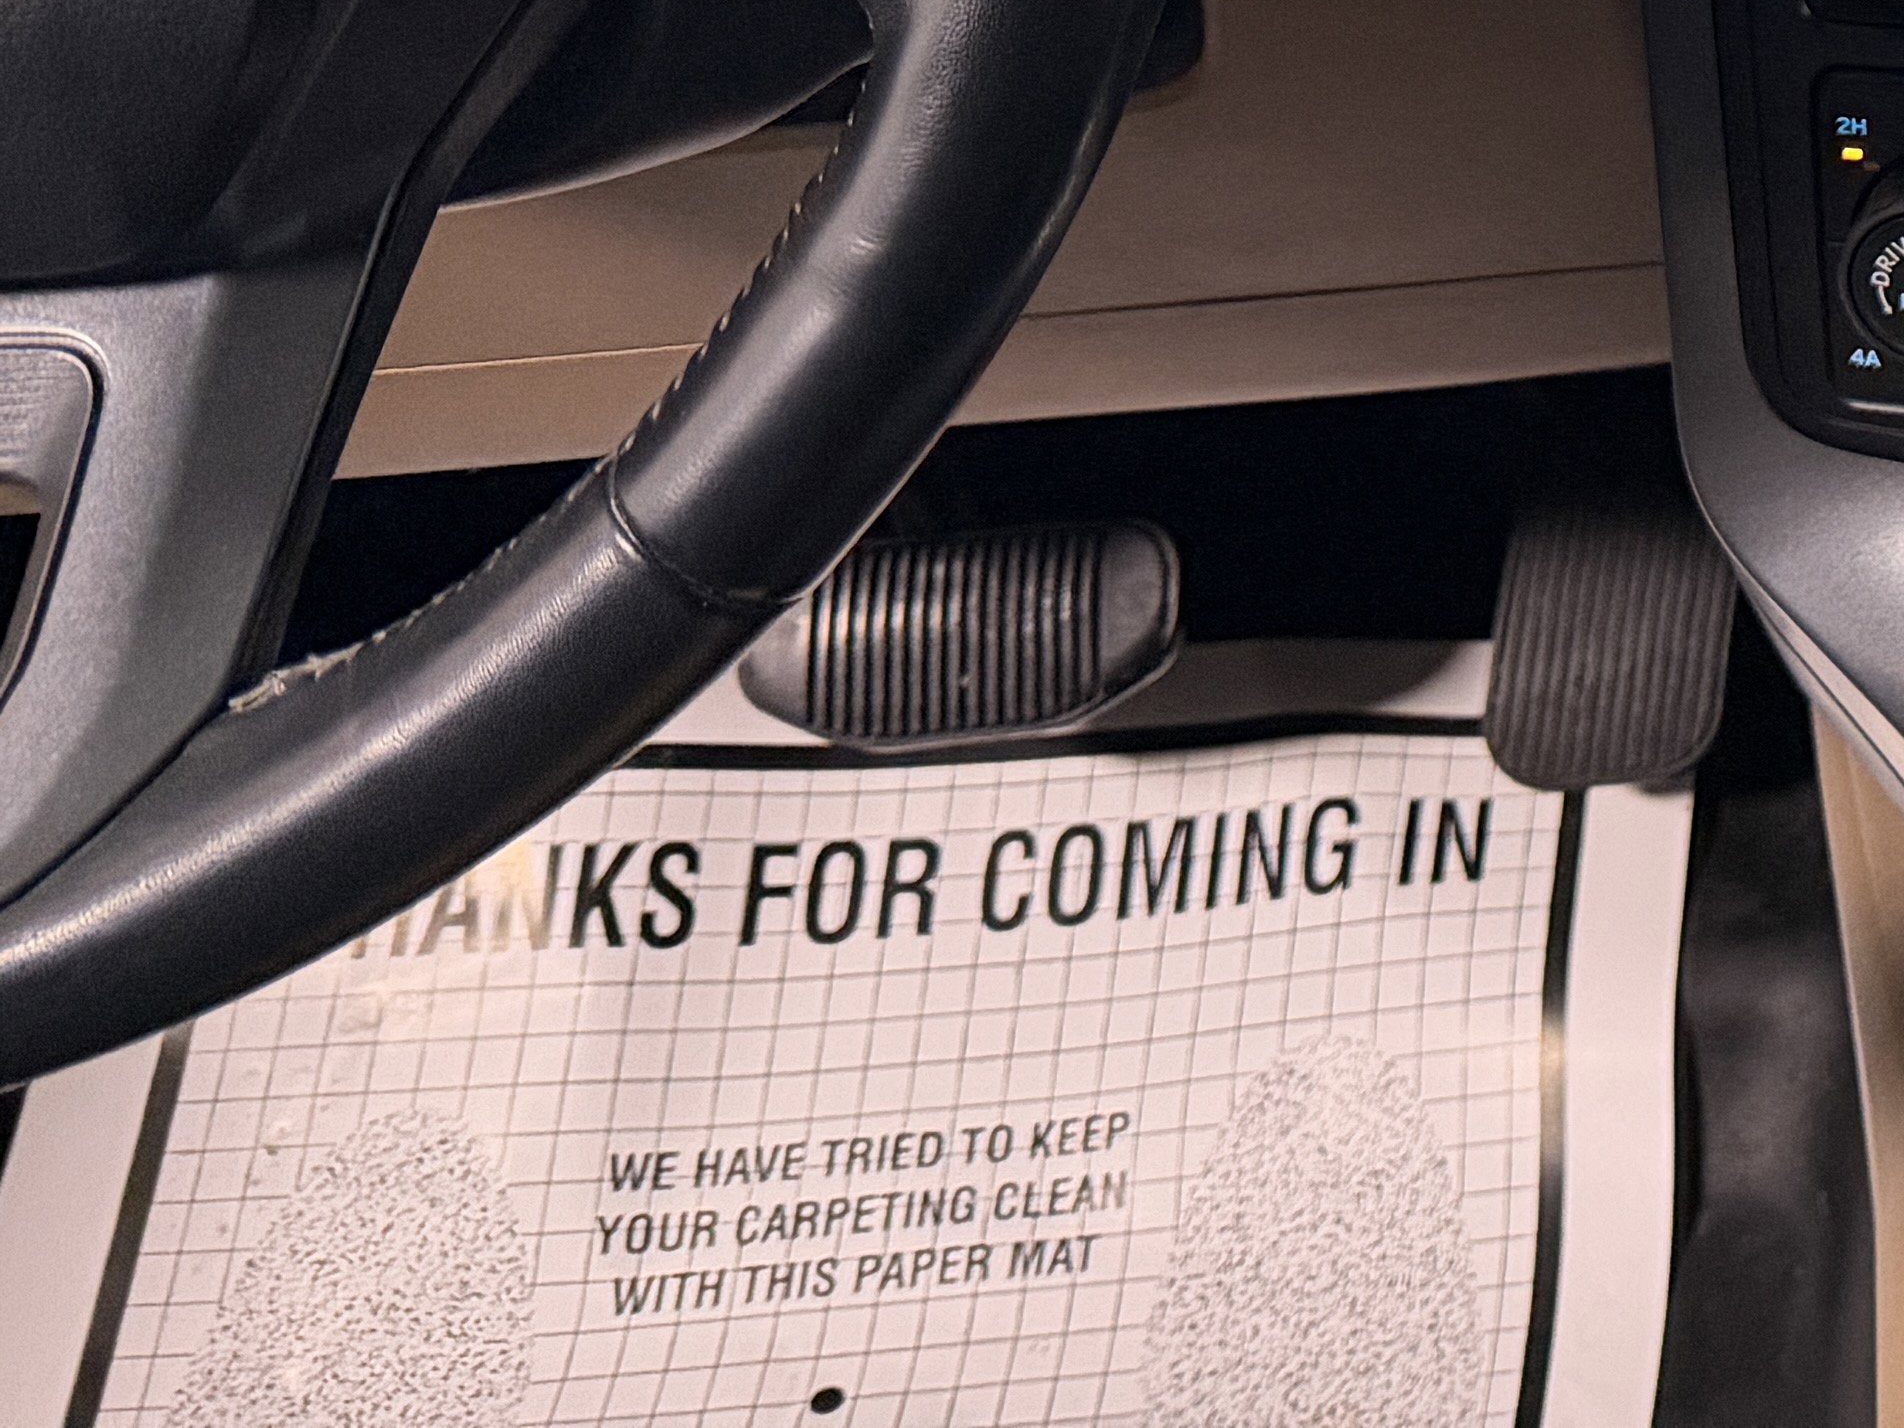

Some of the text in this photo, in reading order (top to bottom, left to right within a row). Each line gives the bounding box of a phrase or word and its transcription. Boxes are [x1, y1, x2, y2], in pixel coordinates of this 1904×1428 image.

[1834, 116, 1869, 136] 2H
[1848, 348, 1882, 370] 4A
[350, 796, 1494, 960] ANKS FOR COMING IN
[607, 1110, 1131, 1193] WE HAVE TRIED TO KEEP
[596, 1170, 1129, 1257] YOUR CARPETING CLEAN
[611, 1234, 1101, 1317] WITH THIS PAPER MAT
